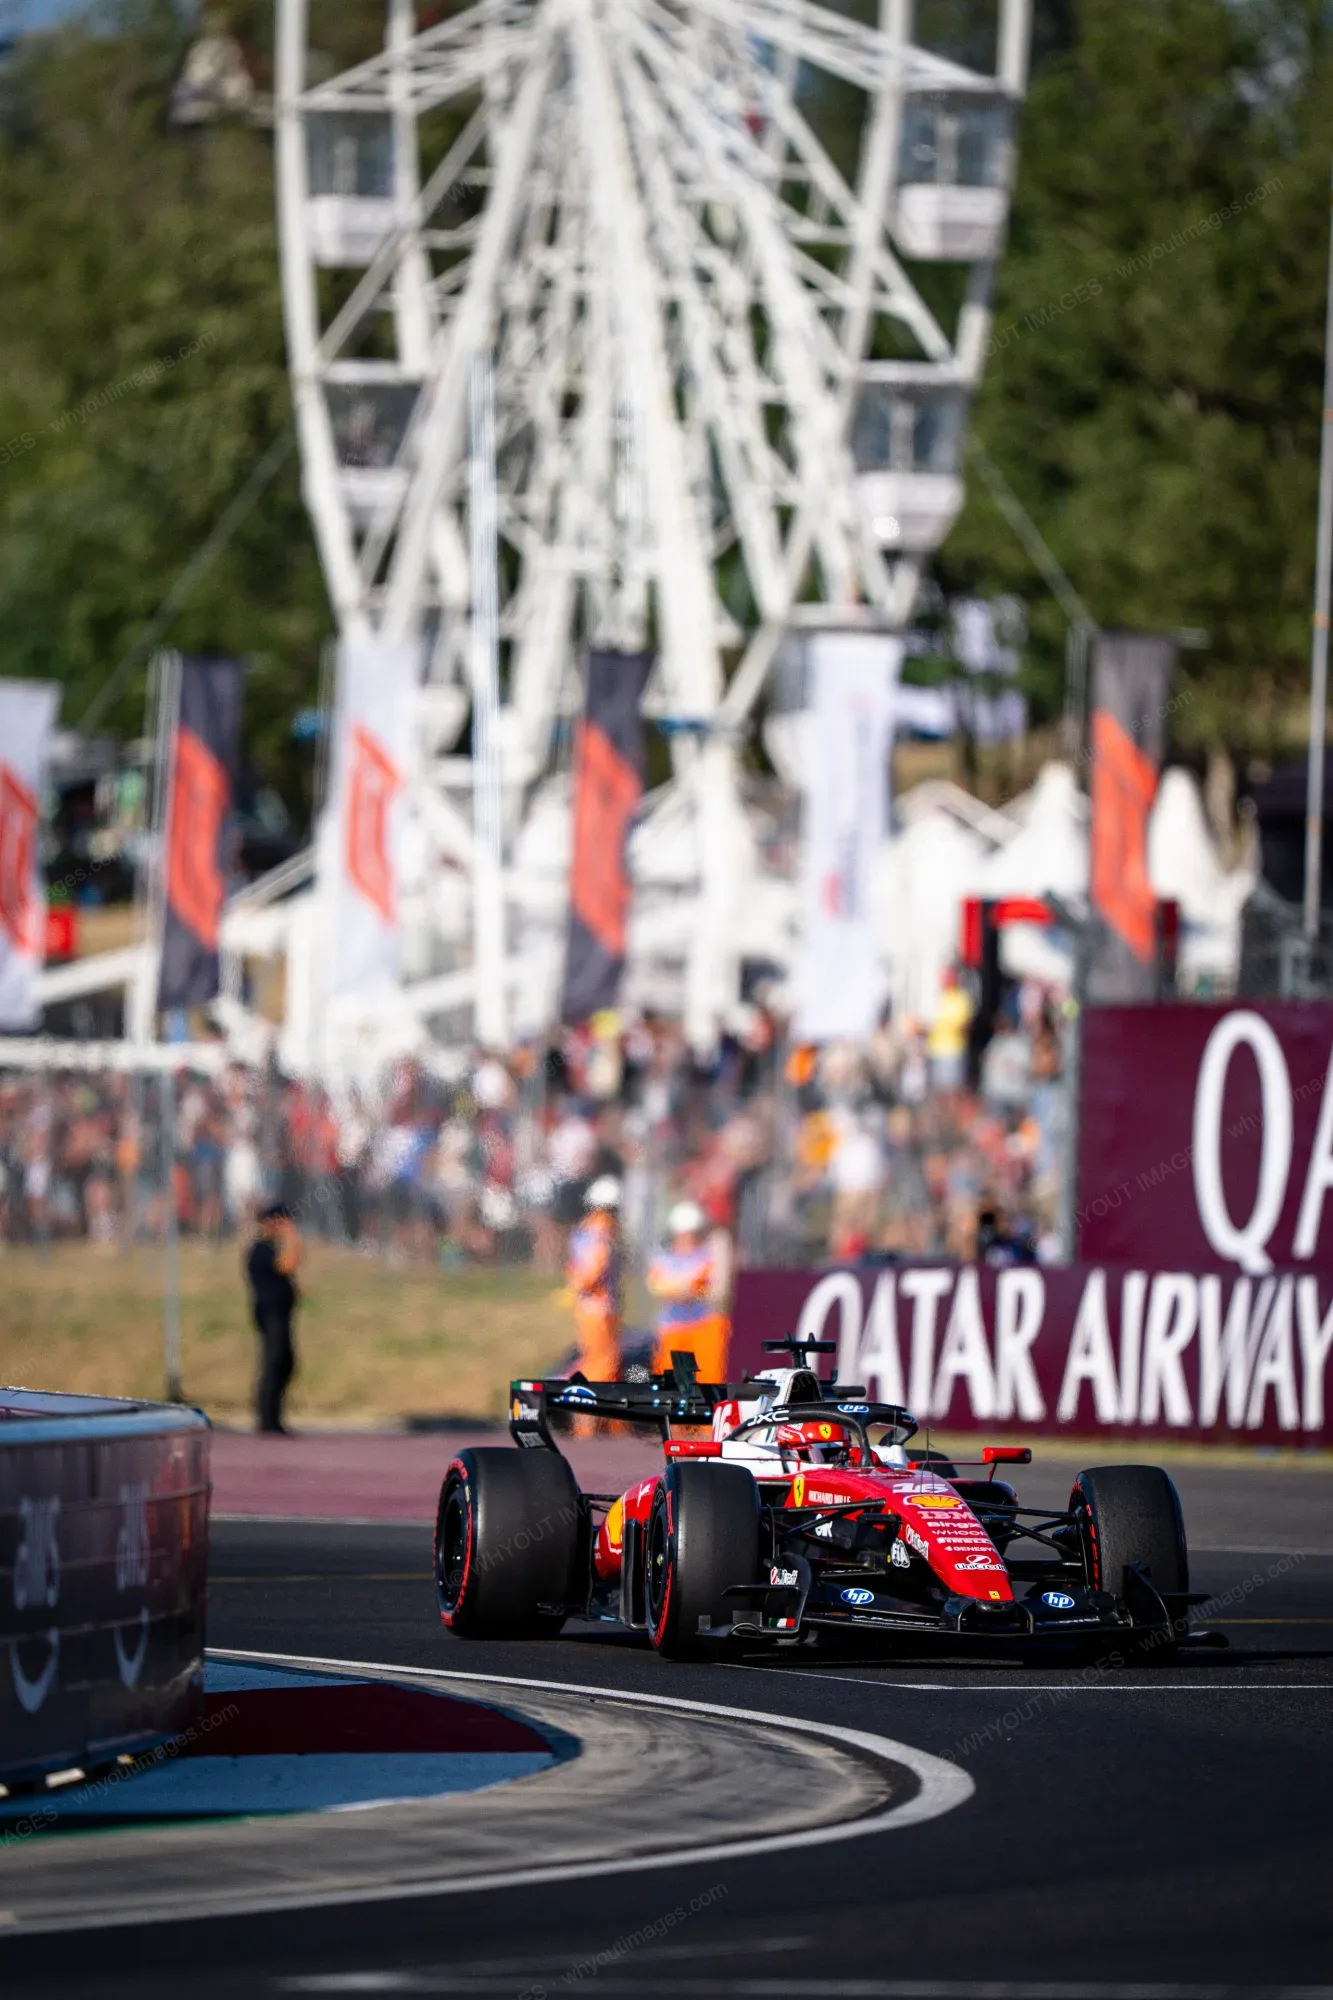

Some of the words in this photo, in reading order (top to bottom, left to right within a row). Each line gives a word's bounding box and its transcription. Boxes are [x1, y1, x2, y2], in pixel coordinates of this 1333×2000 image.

[797, 1267, 1047, 1421] QATAR
[892, 1482, 949, 1494] 16
[808, 1490, 833, 1505] RICHARD
[917, 1510, 976, 1520] IBM
[955, 1562, 1007, 1571] UniCredi
[848, 1588, 869, 1604] hp
[1048, 1592, 1070, 1608] hp
